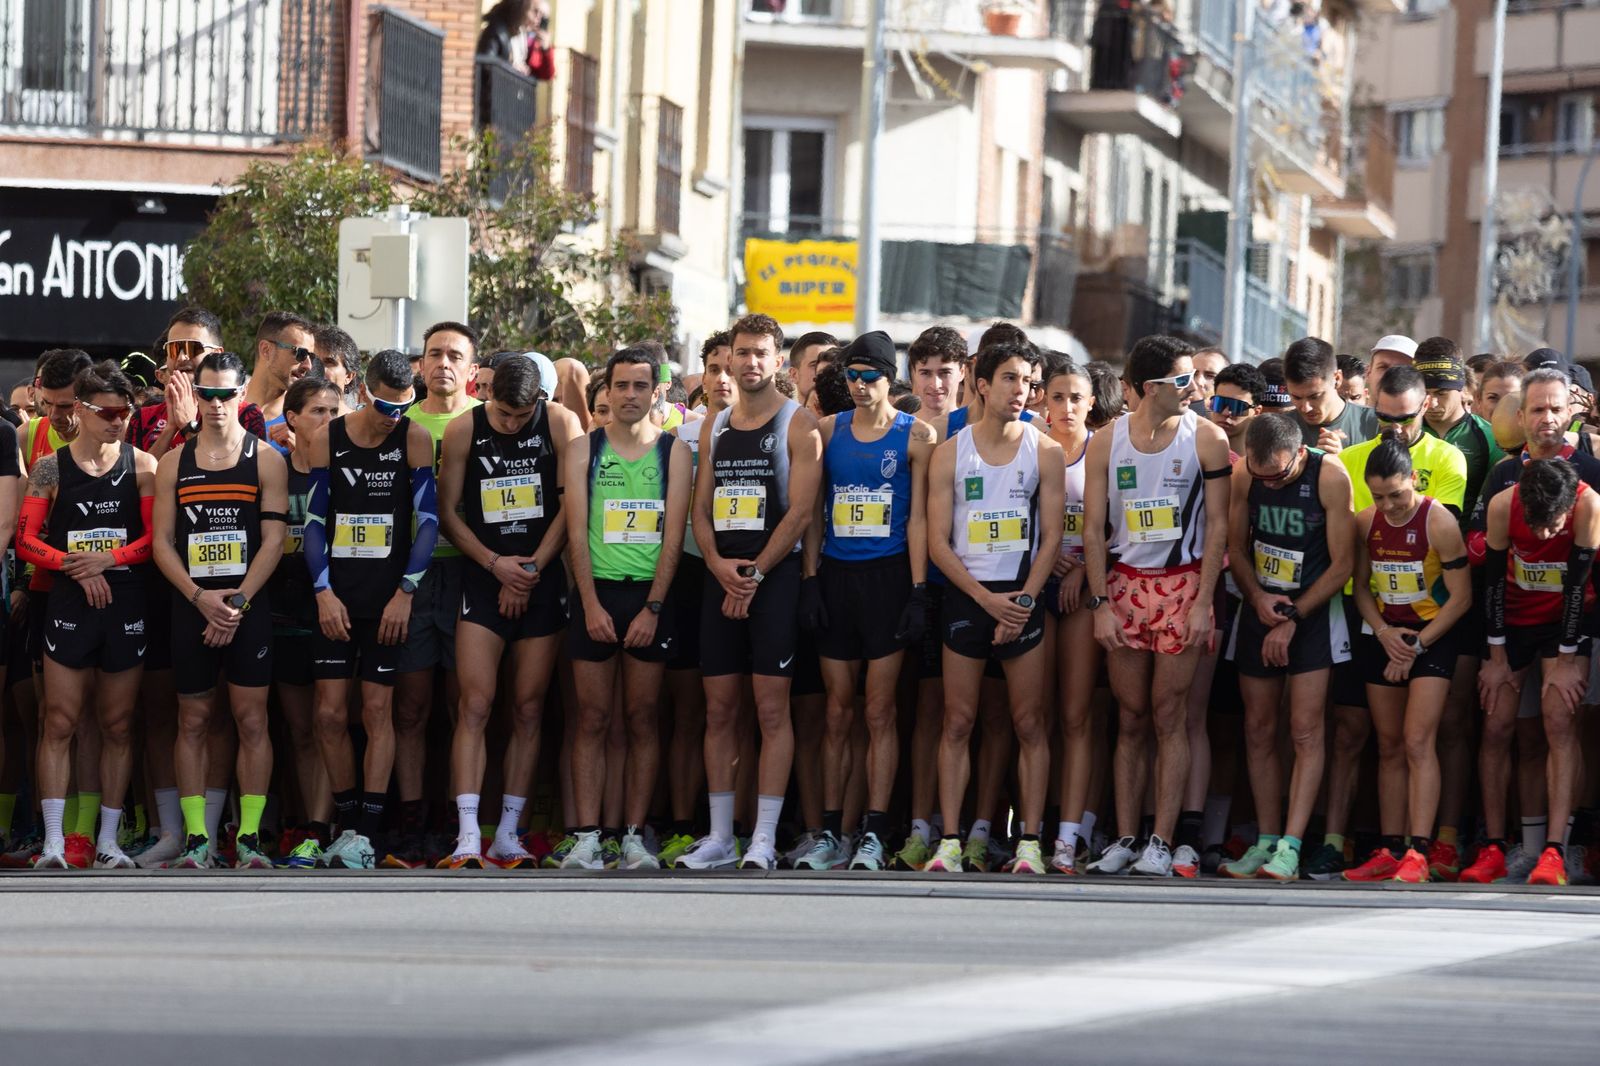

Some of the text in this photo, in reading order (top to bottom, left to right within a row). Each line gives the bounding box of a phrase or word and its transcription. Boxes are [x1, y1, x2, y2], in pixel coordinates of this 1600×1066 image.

[503, 458, 538, 468] VICKY
[732, 459, 769, 467] ATLETISMO
[364, 472, 396, 480] VICKY
[496, 477, 535, 488] SETEL
[501, 488, 516, 506] 14
[726, 488, 760, 496] SETEL
[847, 494, 886, 502] SETEL
[95, 501, 120, 510] VICKY
[729, 498, 738, 515] 3
[1134, 499, 1174, 509] SETEL
[205, 508, 240, 516] VICKY
[850, 504, 864, 522] 15
[982, 510, 1022, 520] SETEL
[349, 516, 388, 524] SETEL
[627, 512, 636, 528] 2
[1139, 510, 1154, 528] 10
[1258, 505, 1305, 537] AVS
[84, 530, 122, 538] SETEL
[351, 526, 366, 543] 16
[989, 521, 999, 539] 9
[204, 533, 242, 543] SETEL
[198, 543, 232, 562] 3681
[1263, 546, 1297, 560] SETEL
[1263, 556, 1280, 575] 40
[1383, 564, 1417, 572] SETEL
[1522, 570, 1547, 582] 102
[1389, 574, 1398, 590] 6
